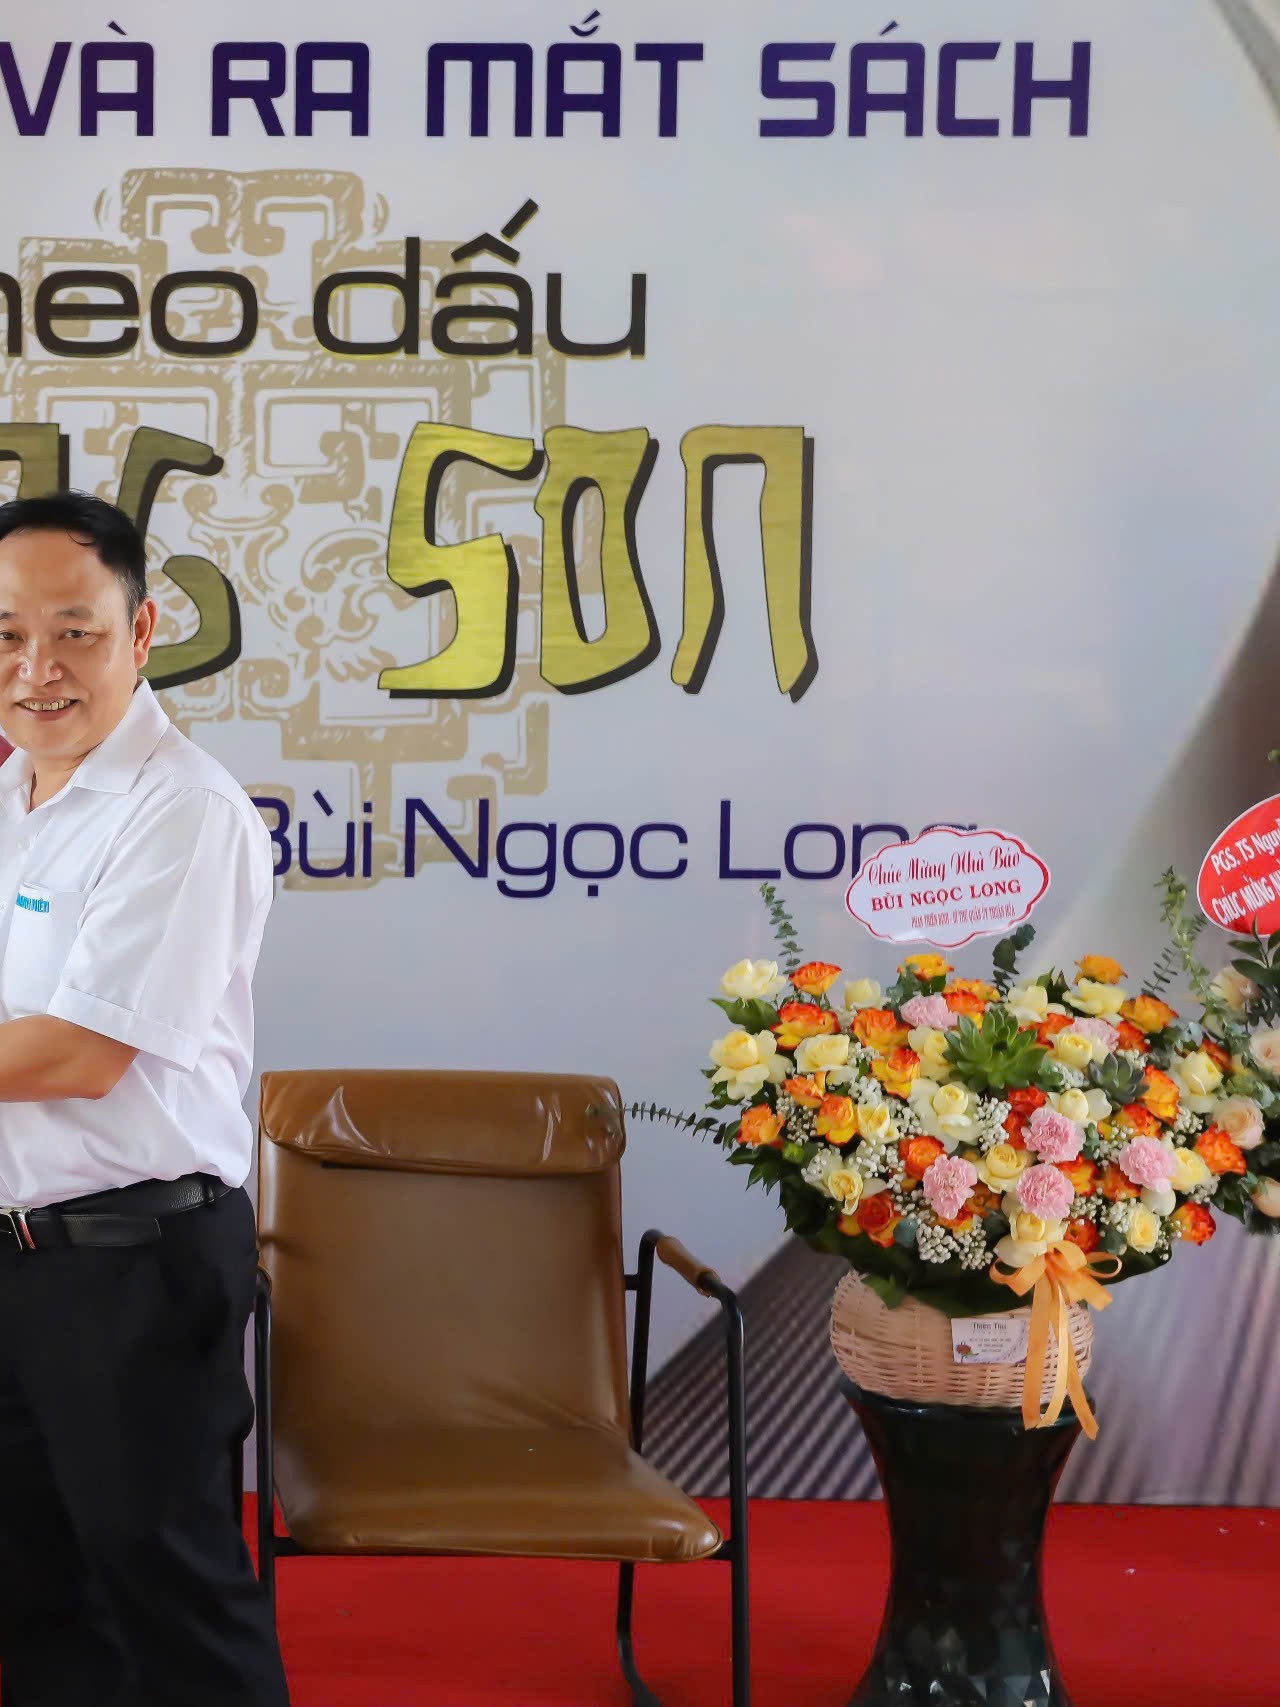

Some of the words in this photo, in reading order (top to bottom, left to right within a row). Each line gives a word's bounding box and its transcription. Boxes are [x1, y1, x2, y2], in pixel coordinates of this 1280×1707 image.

[211, 41, 370, 137] RA
[426, 9, 705, 138] MẮT
[758, 20, 1092, 138] SÁCH
[312, 198, 648, 359] dấu
[404, 799, 688, 898] Ngọc
[720, 799, 977, 880] Lon
[871, 891, 904, 913] BÙI
[910, 886, 963, 907] NGỌC
[970, 878, 1021, 899] LONG
[1210, 846, 1241, 876] PGS.
[1235, 837, 1255, 862] TS
